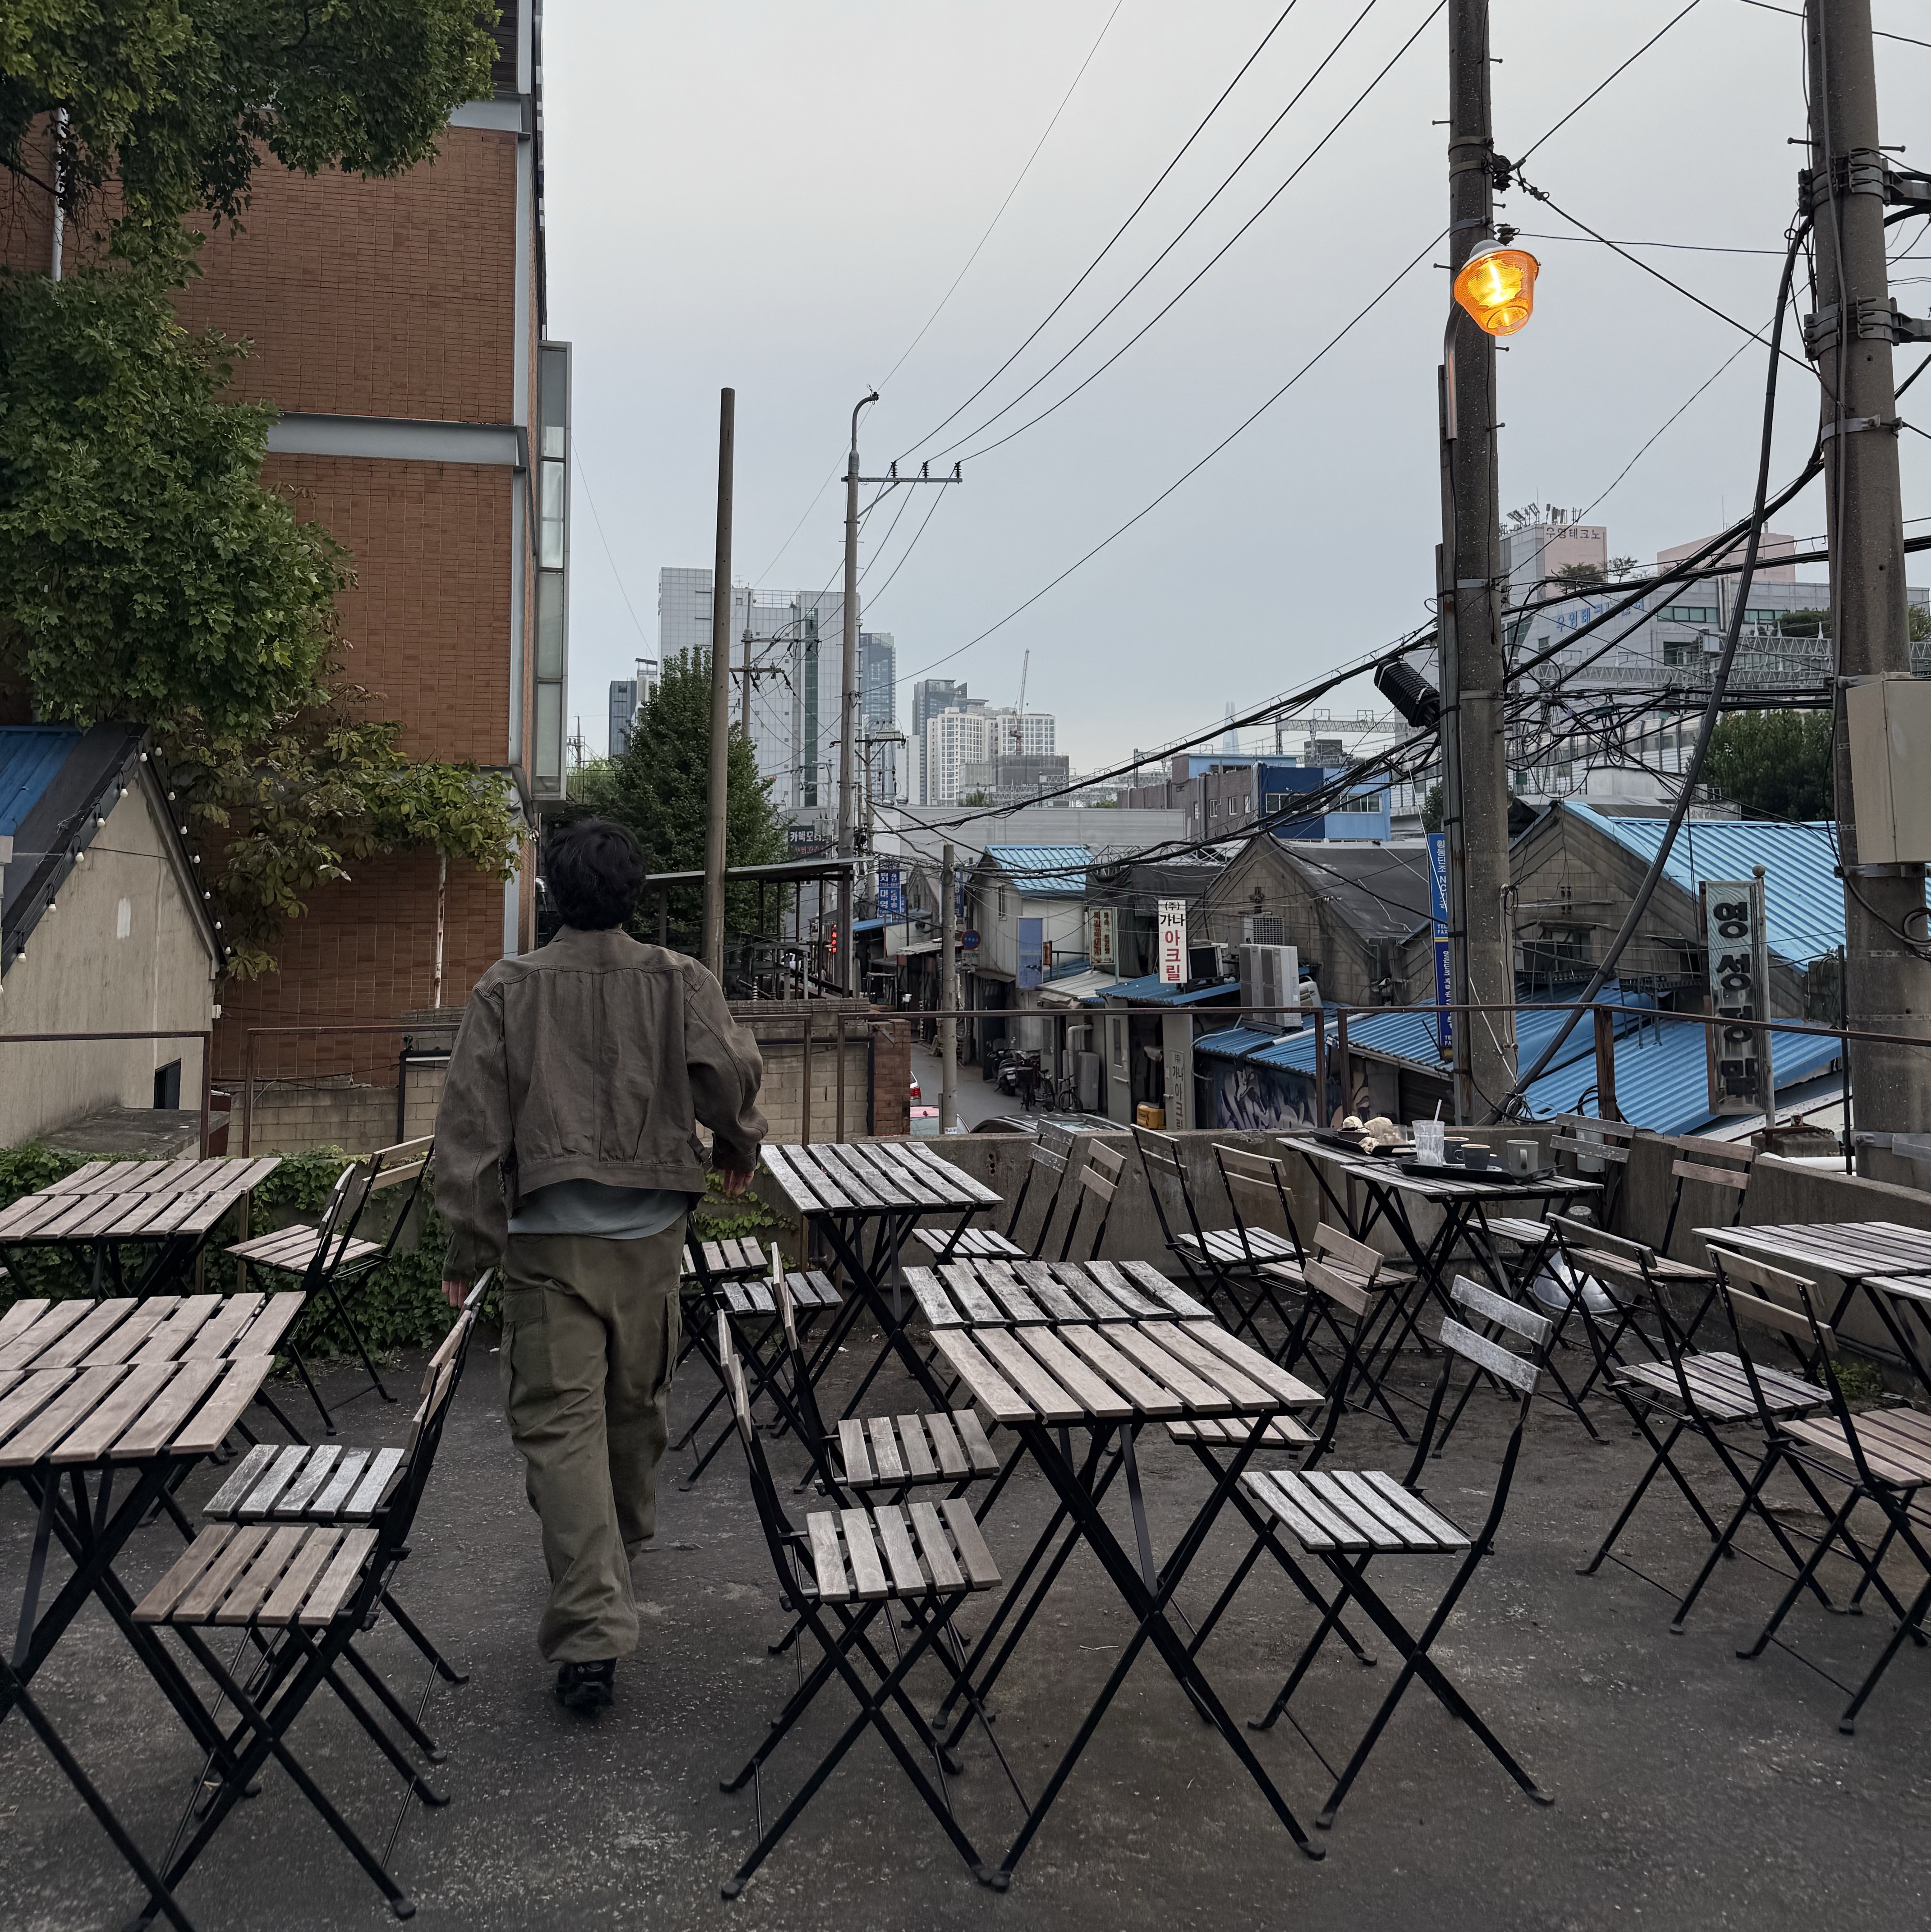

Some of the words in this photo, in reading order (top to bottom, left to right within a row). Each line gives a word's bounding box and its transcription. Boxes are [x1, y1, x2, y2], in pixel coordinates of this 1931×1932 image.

[1546, 527, 1601, 539] 우영테크노
[1165, 901, 1180, 911] (주)
[1160, 914, 1186, 927] 가나
[1165, 930, 1181, 981] 아크릴
[1173, 1066, 1183, 1081] 가나
